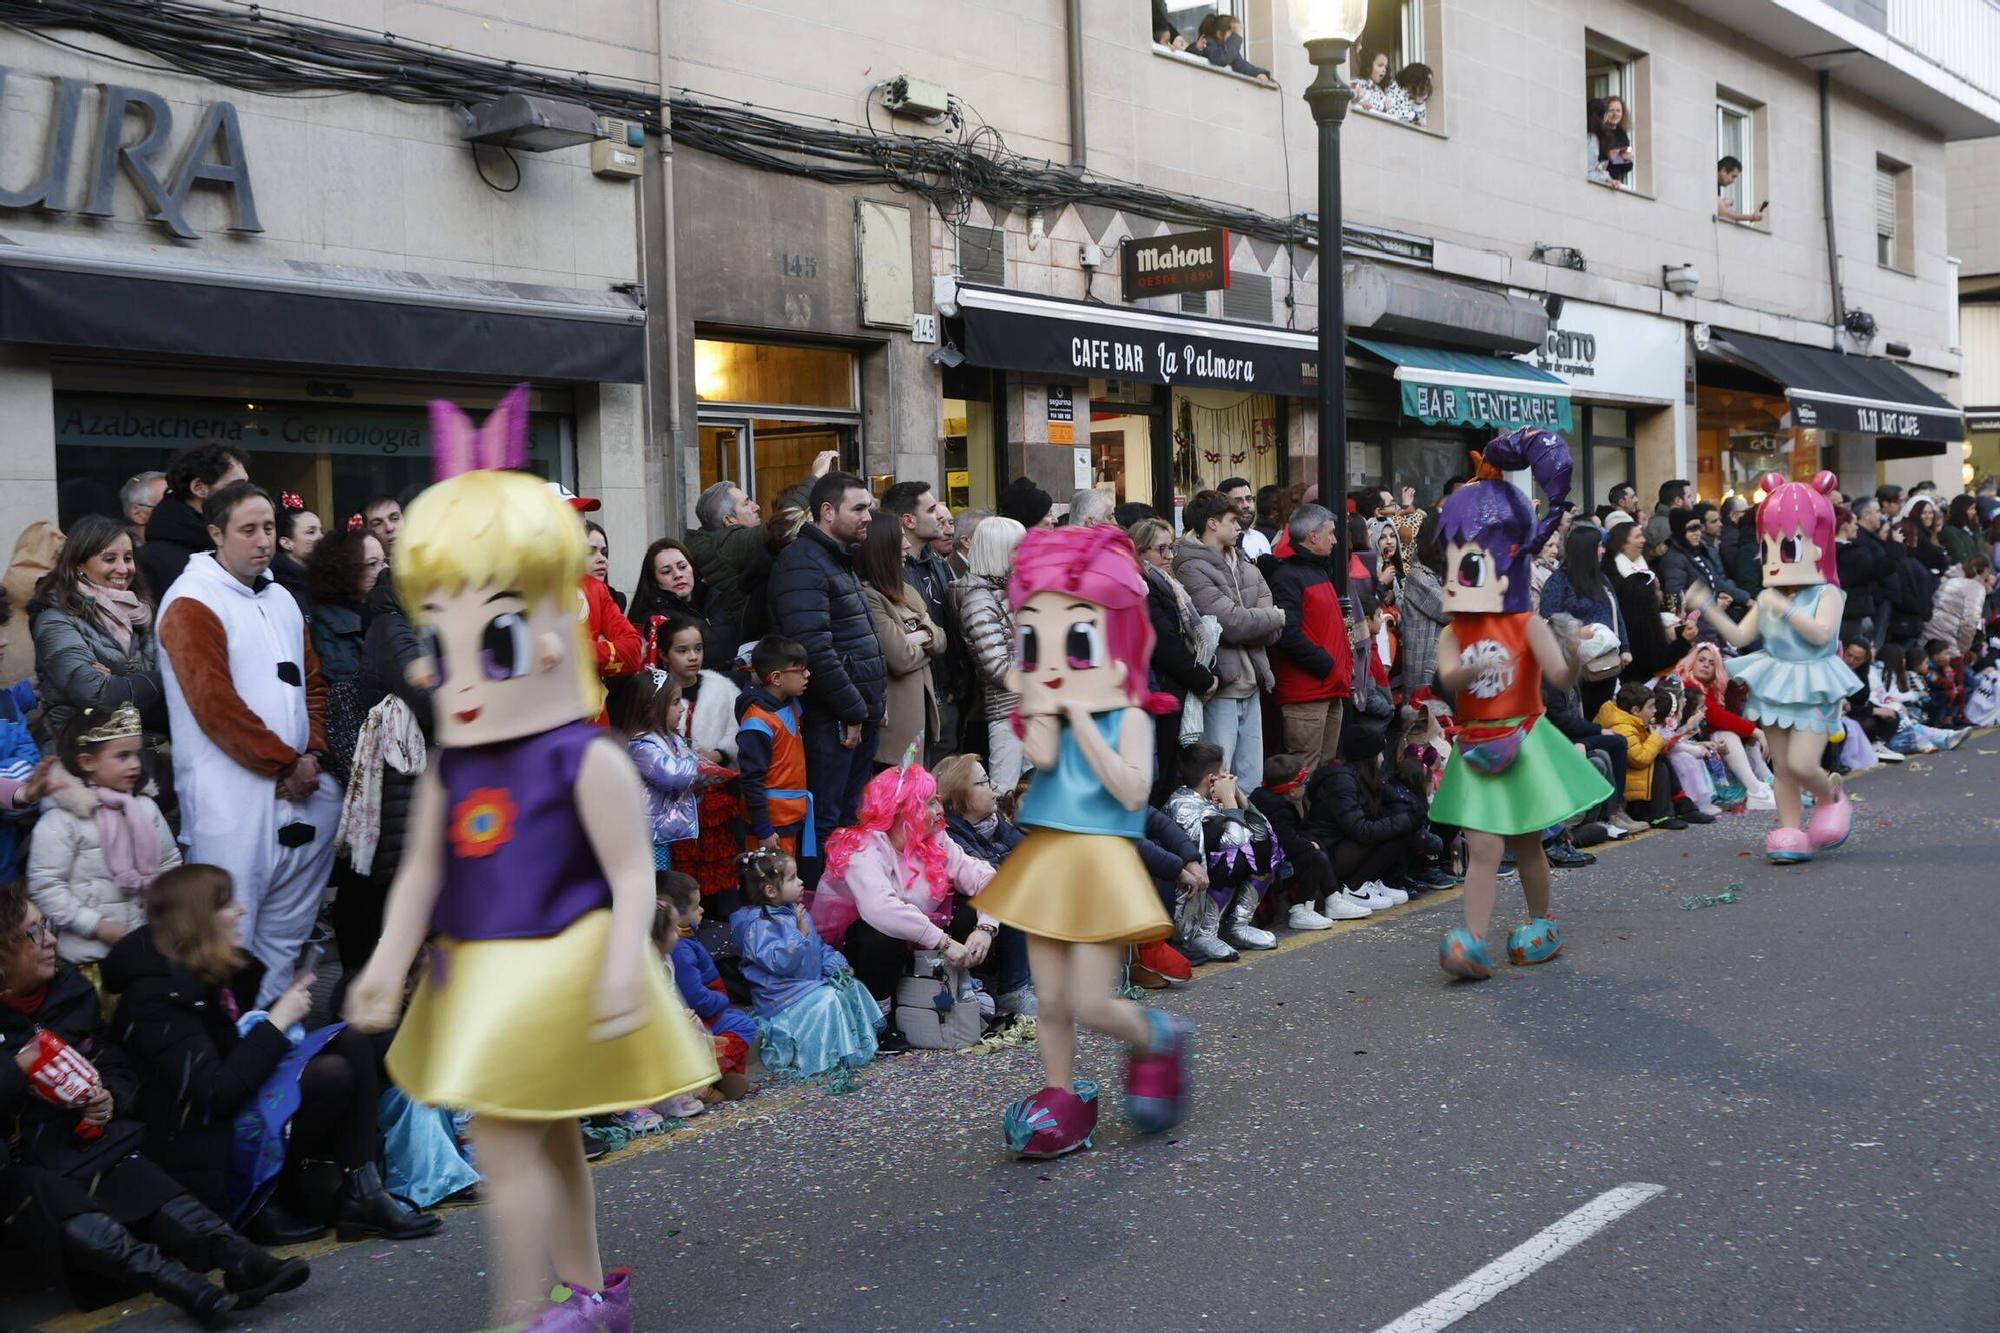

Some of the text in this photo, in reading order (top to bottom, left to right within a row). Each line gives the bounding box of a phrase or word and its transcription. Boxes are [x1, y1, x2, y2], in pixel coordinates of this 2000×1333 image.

[1136, 244, 1213, 272] Mahou
[914, 318, 935, 341] 145
[1072, 337, 1255, 383] CAFE BAR La Palmera
[1417, 387, 1559, 424] BAR TENTEMPIE
[1881, 412, 1898, 434] ART
[1899, 415, 1920, 436] CAFE
